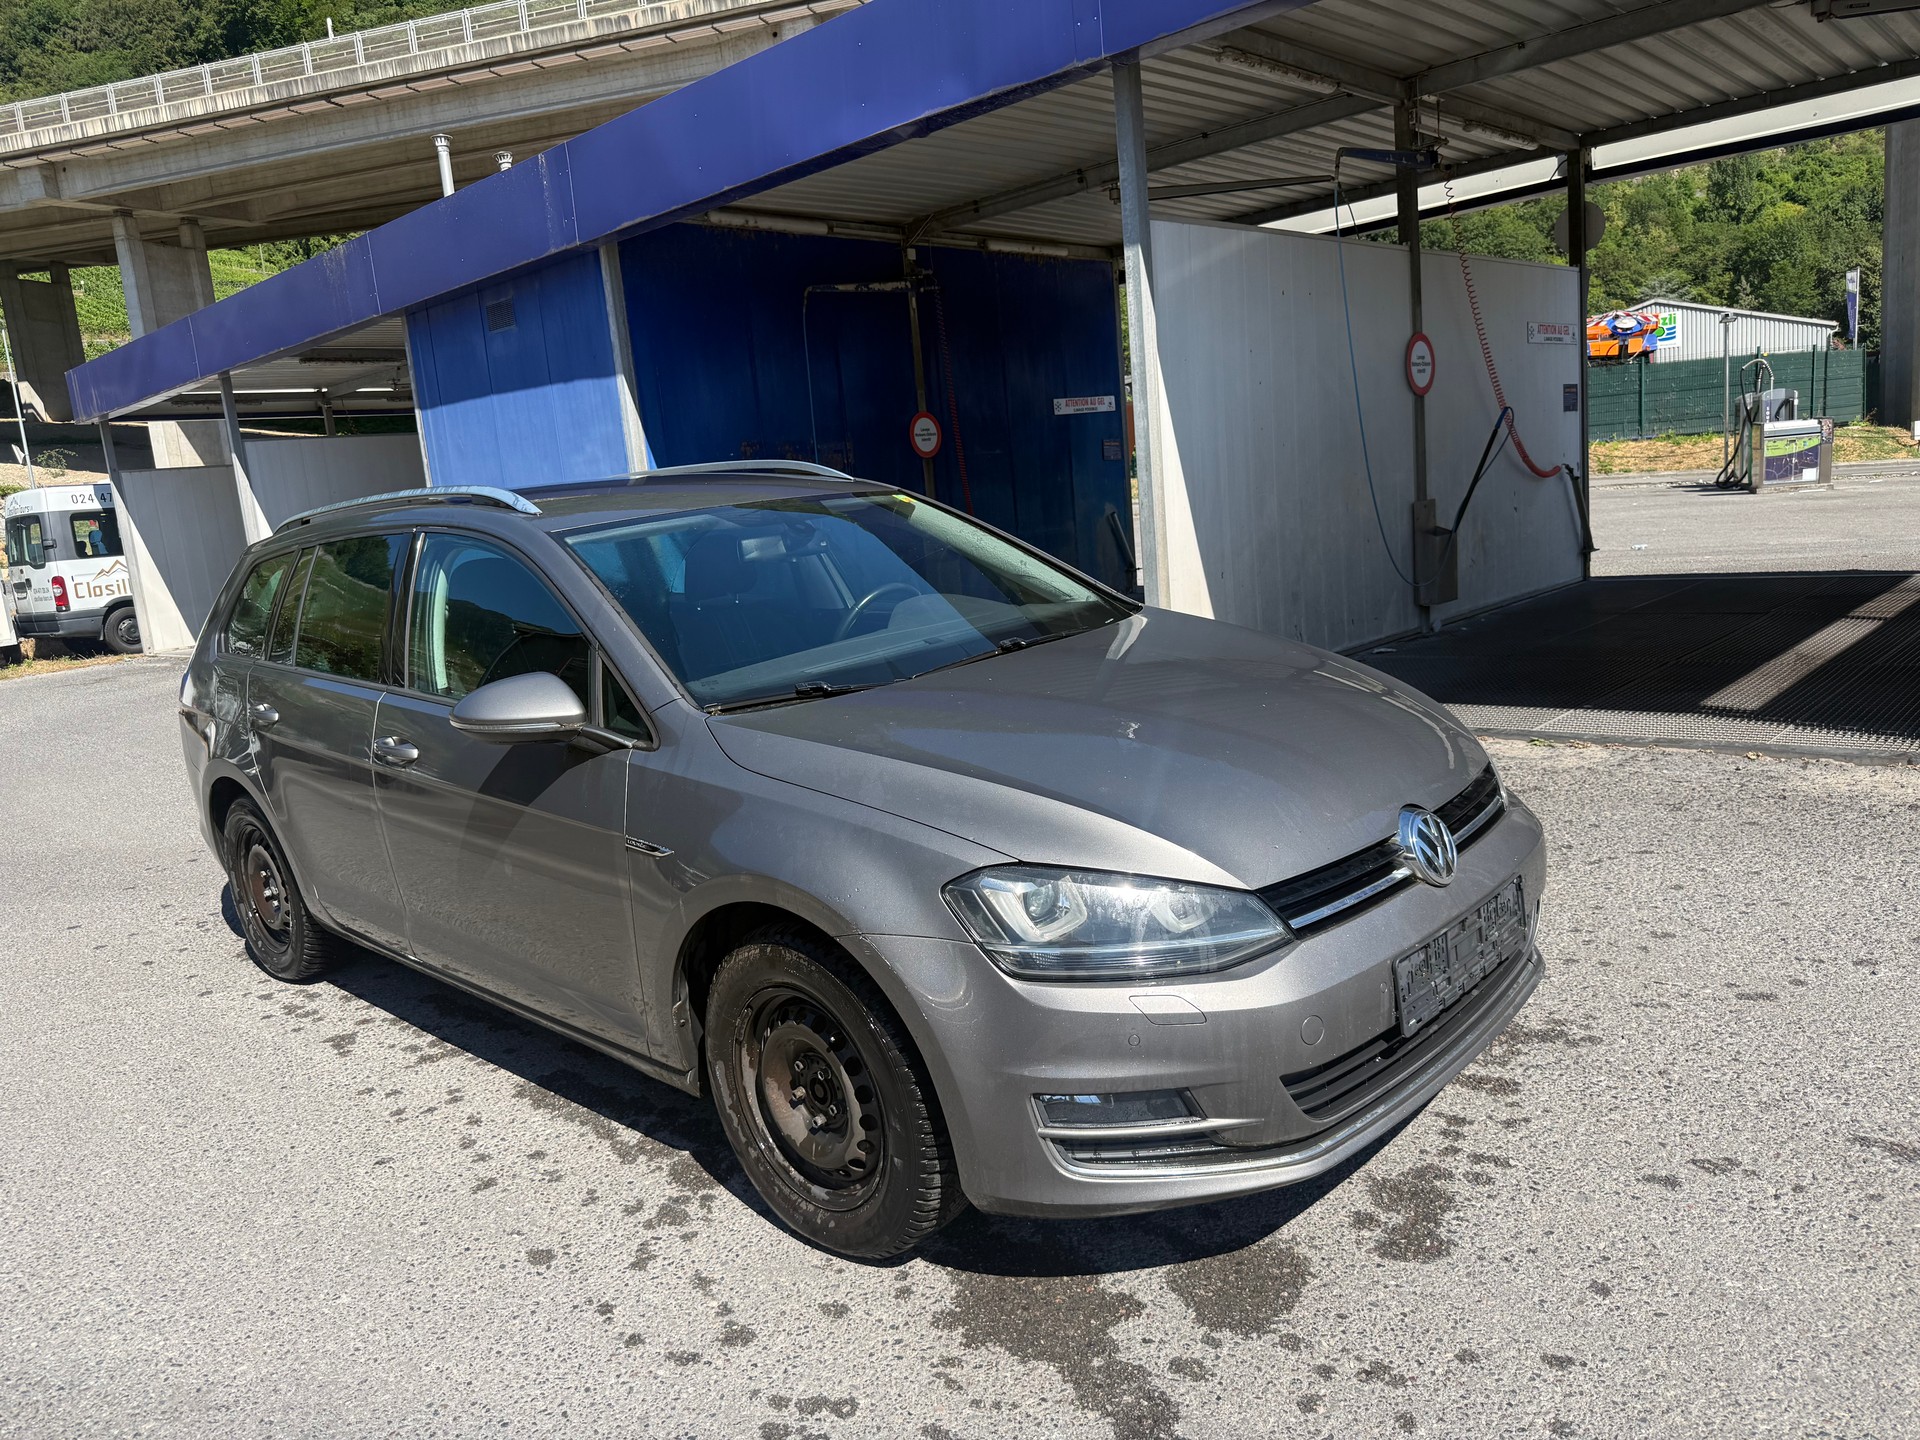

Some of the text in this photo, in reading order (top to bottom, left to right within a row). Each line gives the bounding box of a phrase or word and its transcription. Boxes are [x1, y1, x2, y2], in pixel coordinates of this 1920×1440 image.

[1657, 313, 1677, 326] zli
[1537, 324, 1557, 335] ATTENTION
[1065, 399, 1089, 407] ATTENTION
[1097, 397, 1106, 406] GEL
[71, 492, 112, 504] 024 47
[74, 579, 129, 599] Closil
